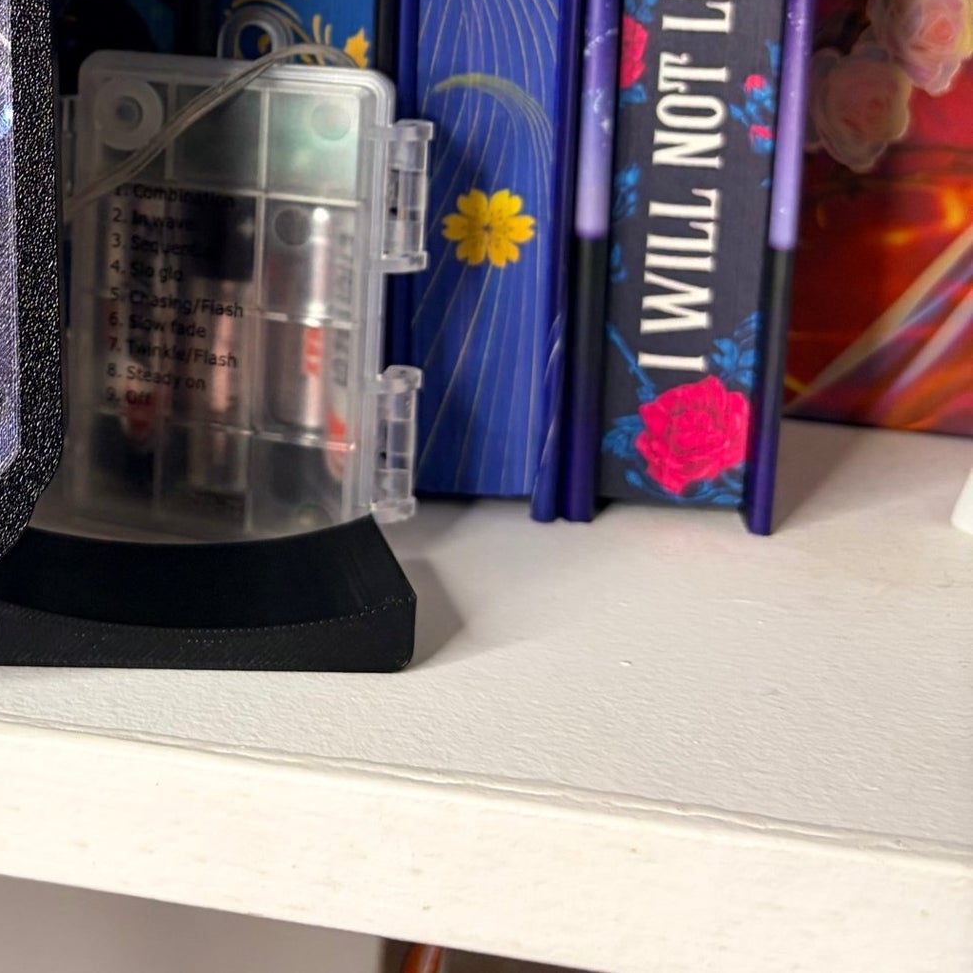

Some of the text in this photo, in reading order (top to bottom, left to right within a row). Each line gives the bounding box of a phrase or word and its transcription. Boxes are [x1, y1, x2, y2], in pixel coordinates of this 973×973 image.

[652, 51, 729, 169] NOT
[112, 207, 127, 223] 2.
[111, 233, 126, 248] 3.
[110, 259, 126, 274] 4.
[640, 187, 720, 334] WILL
[129, 290, 244, 318] Chasing/Flash
[638, 351, 708, 373] I
[126, 365, 182, 389] Steady
[185, 376, 207, 391] on
